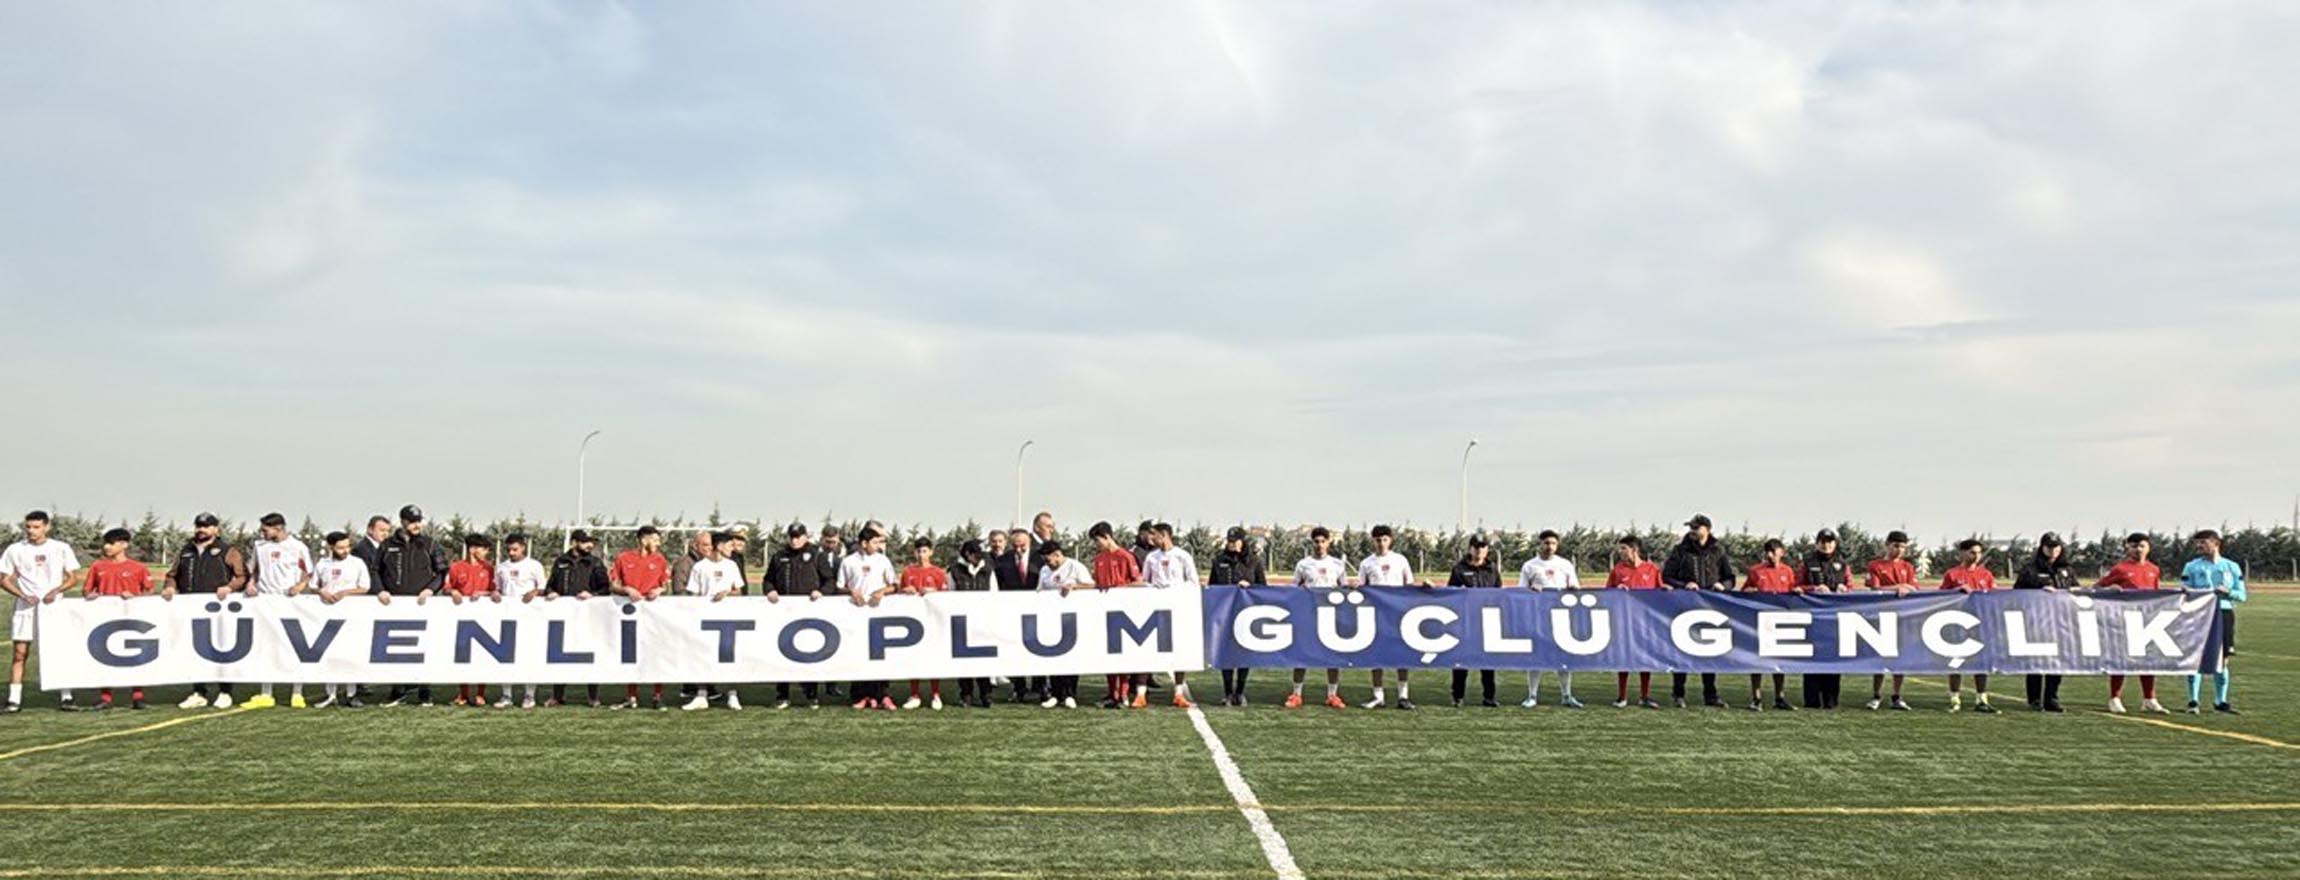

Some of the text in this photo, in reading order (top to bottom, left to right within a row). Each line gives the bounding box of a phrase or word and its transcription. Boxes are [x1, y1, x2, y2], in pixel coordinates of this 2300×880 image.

[87, 601, 1173, 667] GÜVENLİ TOPLUM
[1233, 591, 2184, 669] GÜÇLÜ GENÇLİK
